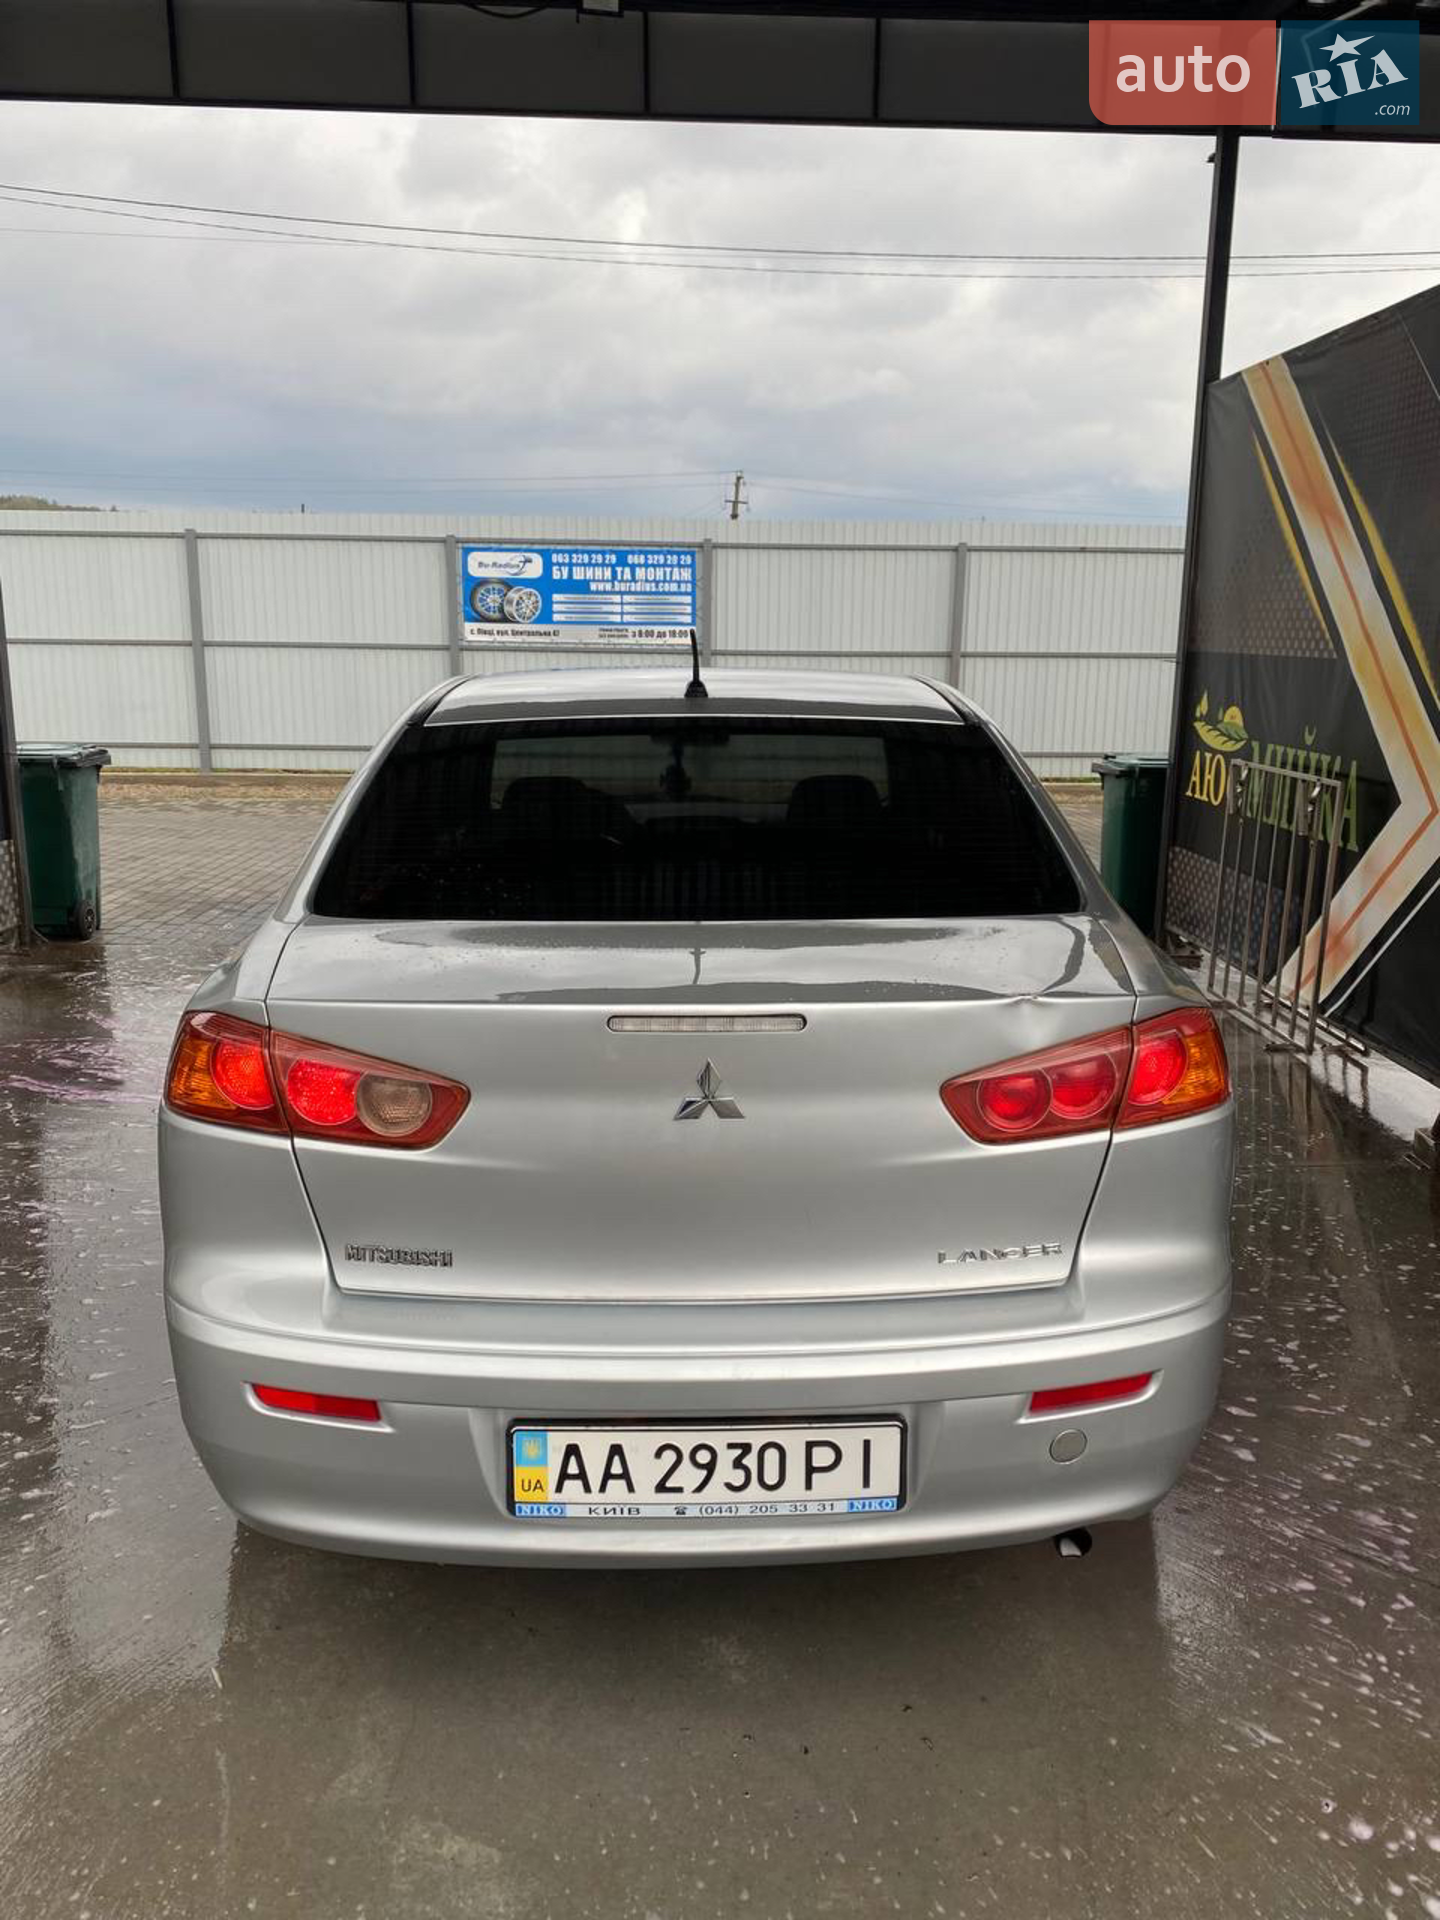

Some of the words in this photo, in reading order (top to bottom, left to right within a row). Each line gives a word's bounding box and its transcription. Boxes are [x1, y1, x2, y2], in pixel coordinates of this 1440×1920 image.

[552, 566, 569, 580] БУ
[572, 566, 613, 580] ШИНИ
[615, 567, 632, 581] ТА
[635, 567, 692, 581] МОНТАЖ
[589, 581, 692, 593] www.buradius.com.ua
[344, 1244, 453, 1268] MITSUBISHI
[937, 1243, 1062, 1264] LANCER
[554, 1443, 636, 1494] AA
[653, 1440, 787, 1493] 2930
[520, 1479, 545, 1493] UA
[516, 1504, 564, 1516] NIKO
[588, 1505, 641, 1516] КИЇВ
[699, 1504, 740, 1516] (044)
[748, 1503, 779, 1515] 205
[788, 1503, 809, 1514] 33
[816, 1502, 836, 1513] 31
[848, 1499, 897, 1512] NIKO
